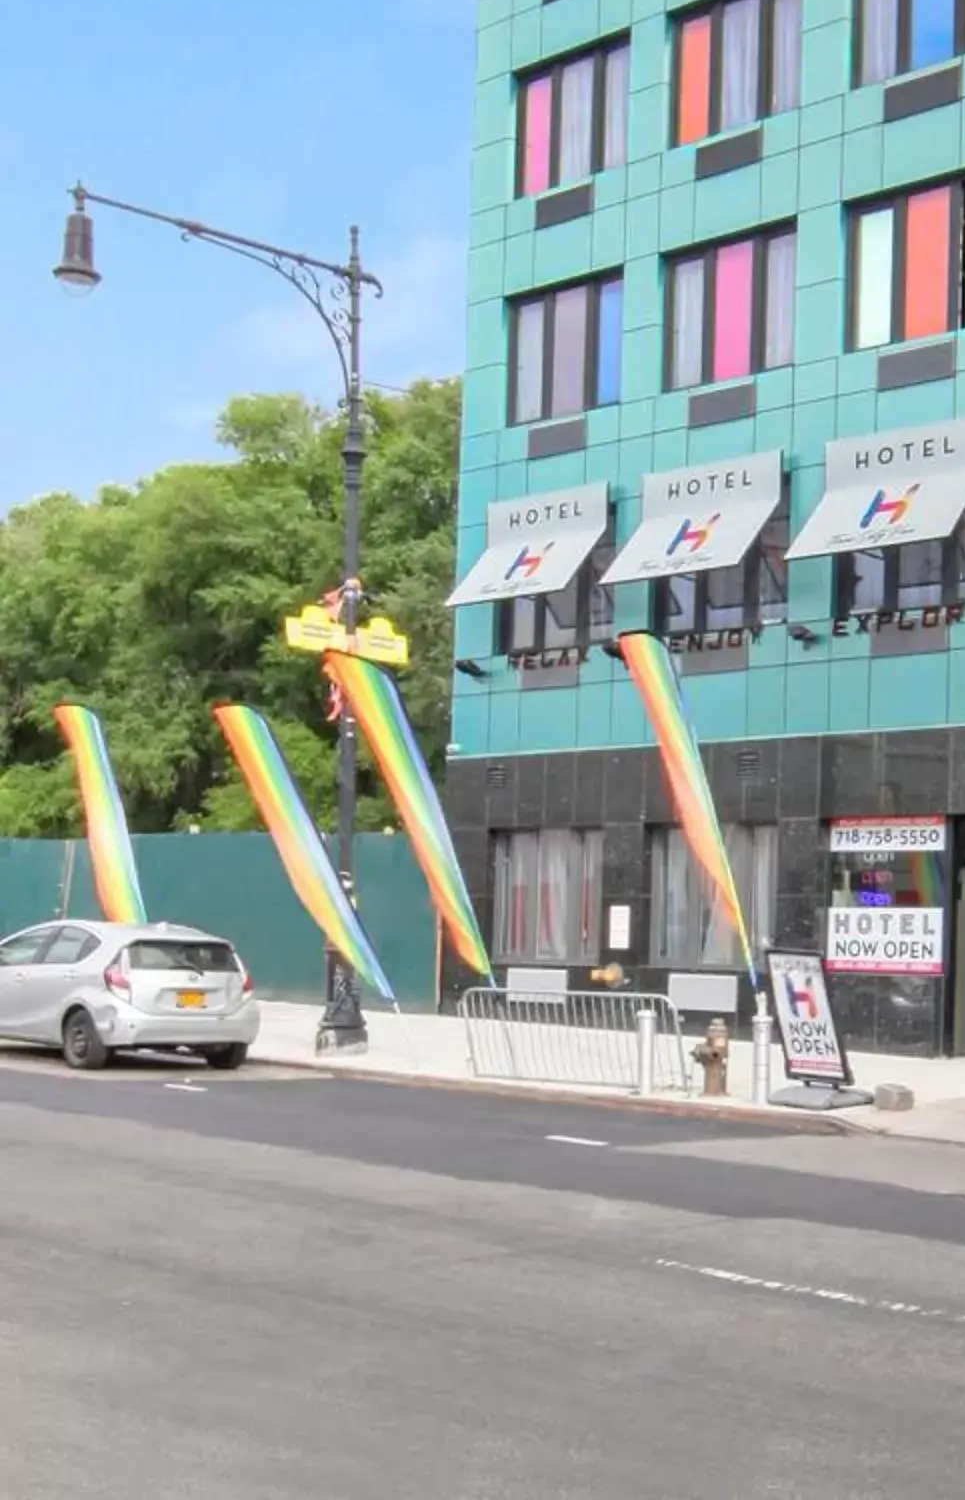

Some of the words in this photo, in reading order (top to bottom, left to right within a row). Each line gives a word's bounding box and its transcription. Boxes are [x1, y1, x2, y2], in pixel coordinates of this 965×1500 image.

[855, 436, 955, 469] HOTEL
[667, 468, 753, 500] HOTEL
[509, 501, 583, 528] HOTEL
[668, 624, 764, 653] ENJOY
[508, 645, 590, 671] RELAX
[834, 913, 936, 936] HOTEL
[836, 939, 879, 958] NOW
[884, 940, 934, 959] OPEN
[788, 1021, 828, 1037] NOW
[791, 1038, 837, 1056] OPEN
